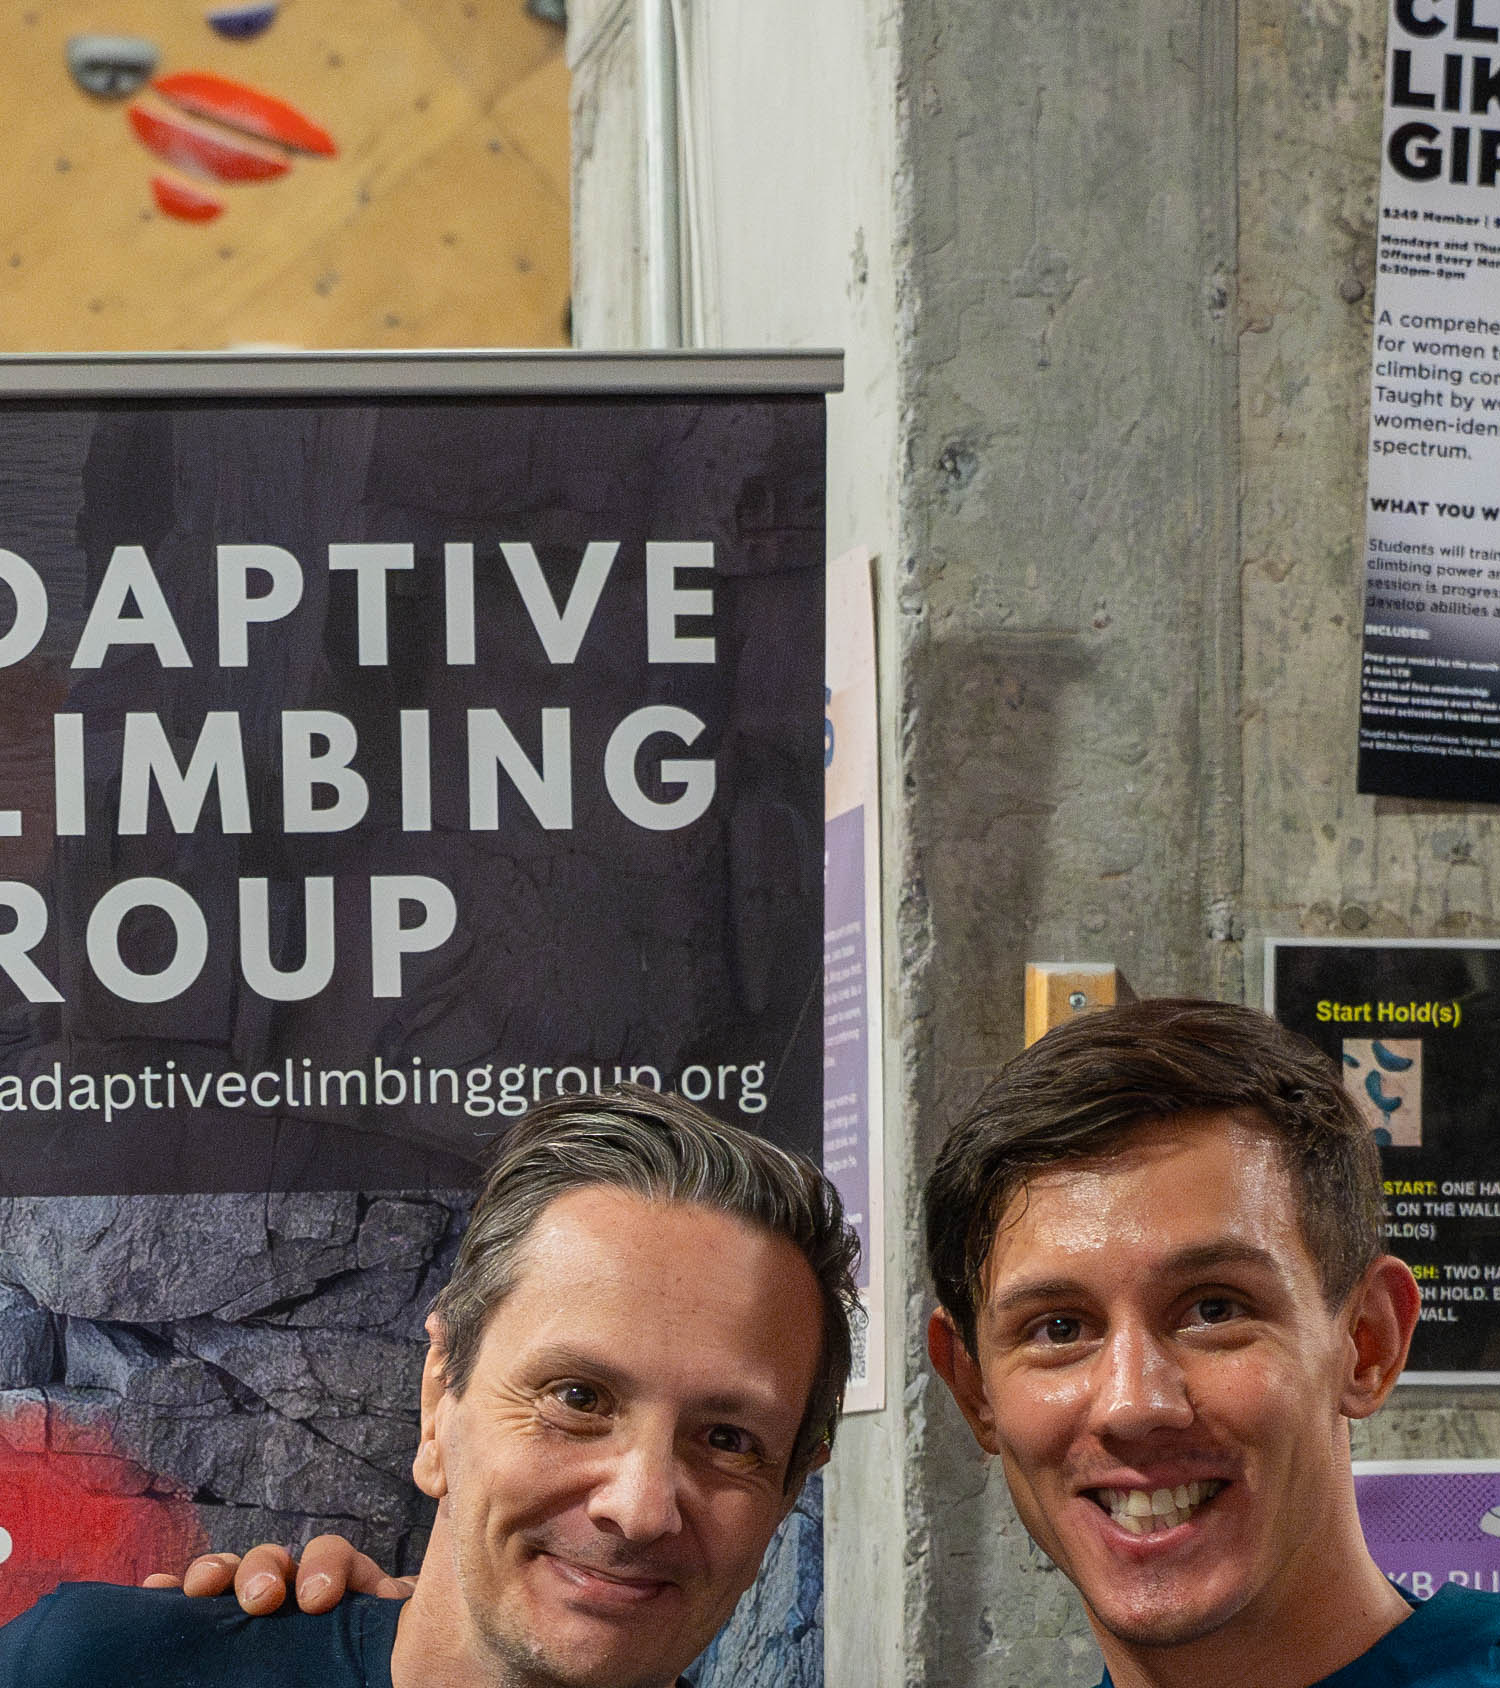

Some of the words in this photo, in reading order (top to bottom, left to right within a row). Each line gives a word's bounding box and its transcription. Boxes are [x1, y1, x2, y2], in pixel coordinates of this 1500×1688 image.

[1423, 211, 1480, 226] Member
[1380, 234, 1440, 250] Mondays
[1443, 240, 1469, 252] and
[1435, 253, 1473, 268] Every
[1378, 310, 1393, 326] A
[1376, 334, 1405, 351] for
[1412, 340, 1485, 359] women
[1375, 360, 1463, 386] climbing
[1374, 385, 1444, 409] Taught
[1449, 389, 1475, 412] by
[1372, 438, 1472, 460] spectrum.
[1370, 497, 1430, 517] WHAT
[1435, 501, 1476, 520] YOU
[1368, 537, 1435, 557] Students
[1438, 545, 1465, 558] will
[1367, 557, 1432, 578] climbing
[1436, 564, 1484, 581] power
[1367, 576, 1421, 593] session
[1425, 580, 1437, 594] is
[1429, 600, 1489, 619] abilities
[1315, 1000, 1372, 1023] Start
[1378, 1000, 1462, 1028] Hold(s)
[1383, 1180, 1438, 1196] START:
[1441, 1181, 1475, 1196] ONE
[1395, 1201, 1421, 1217] ON
[1424, 1202, 1456, 1217] THE
[1443, 1264, 1481, 1281] TWO
